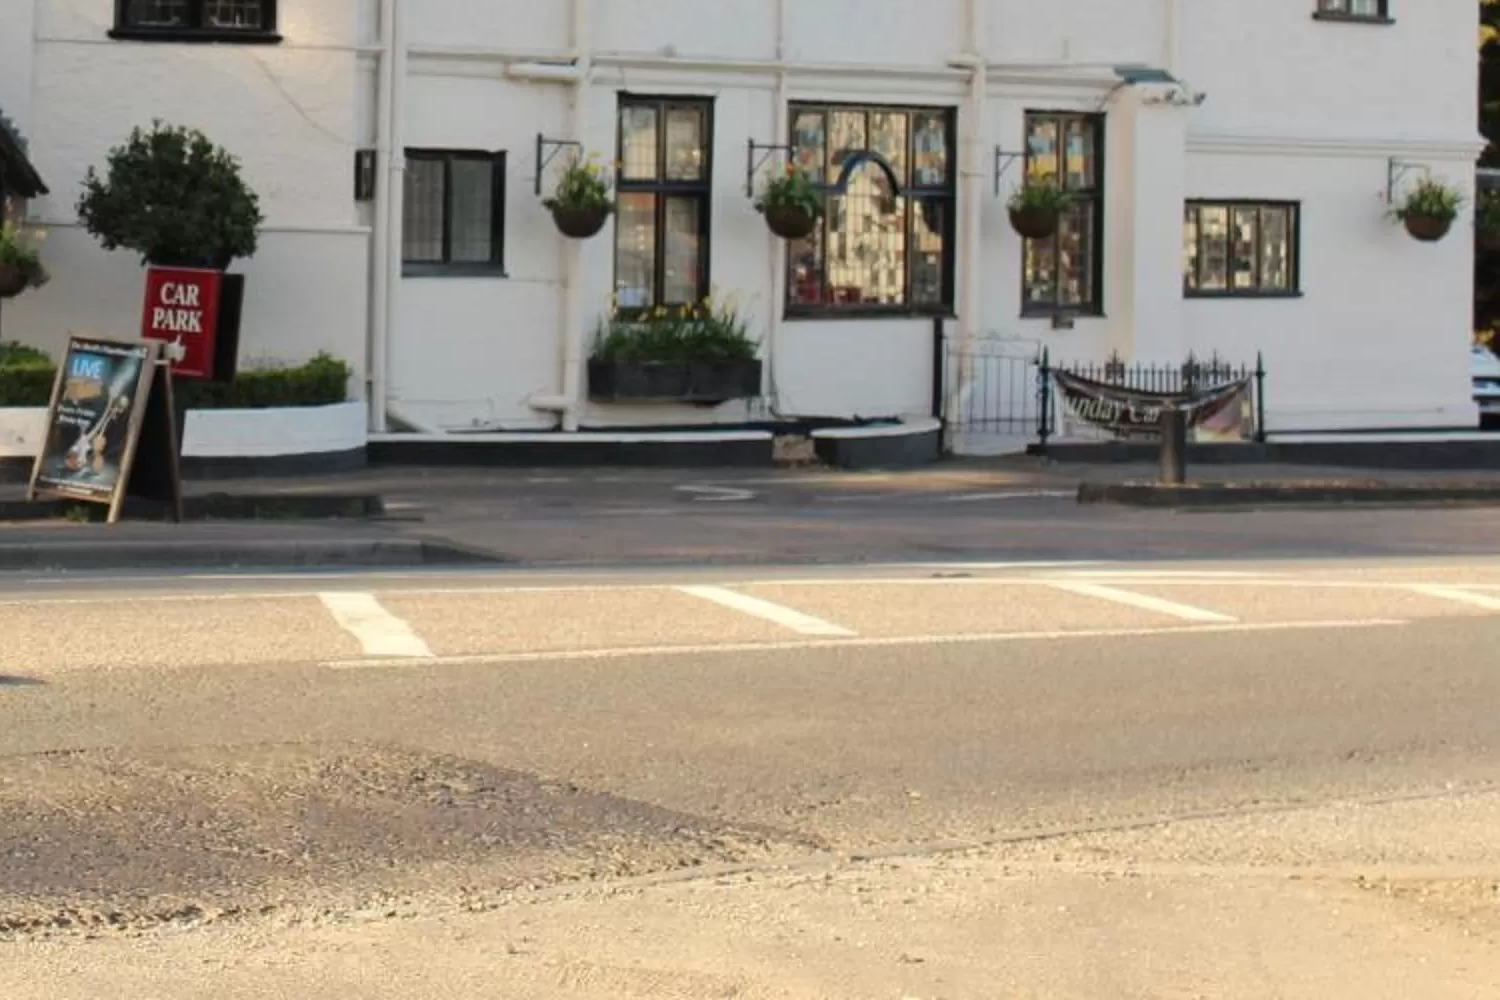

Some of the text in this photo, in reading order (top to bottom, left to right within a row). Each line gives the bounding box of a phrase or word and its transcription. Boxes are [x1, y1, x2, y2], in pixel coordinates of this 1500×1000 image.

[160, 282, 199, 307] CAR
[152, 306, 203, 333] PARK
[72, 357, 104, 379] LIVE
[1063, 394, 1123, 427] unday
